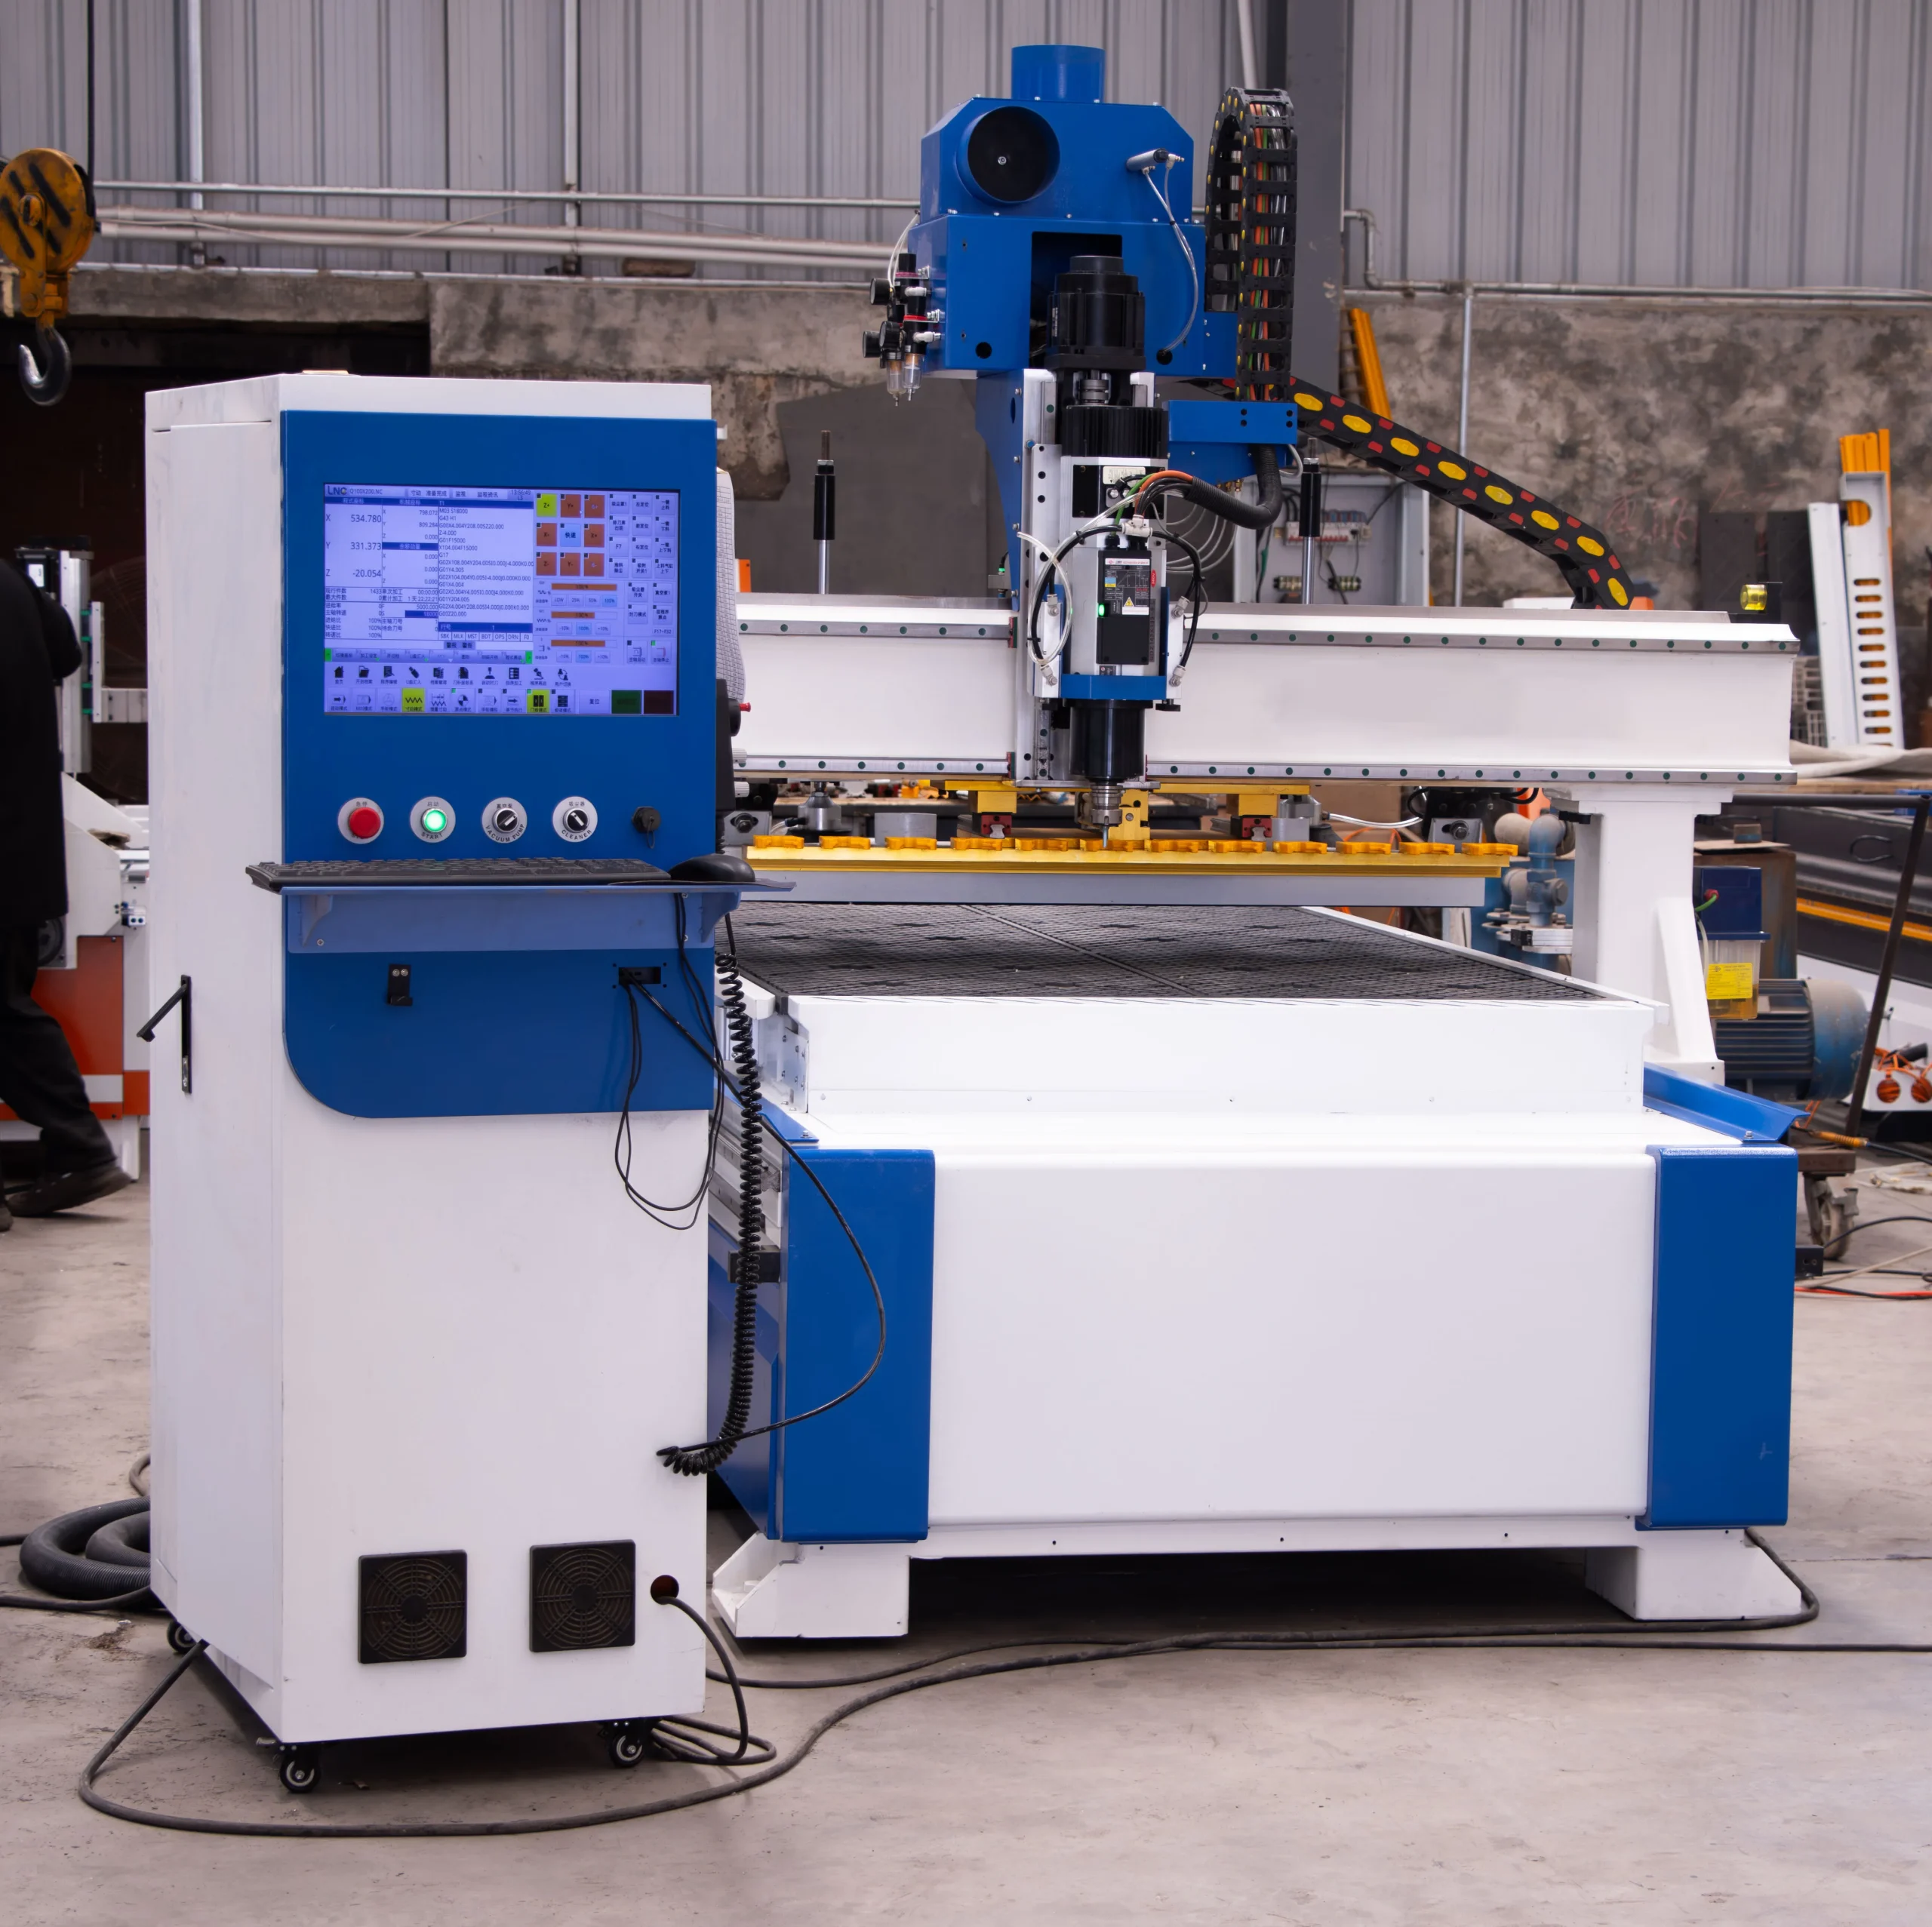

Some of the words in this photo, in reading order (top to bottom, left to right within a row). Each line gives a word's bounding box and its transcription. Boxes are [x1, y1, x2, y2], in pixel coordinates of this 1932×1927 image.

[328, 486, 347, 496] LNC
[350, 542, 381, 550] 331.373
[421, 831, 443, 840] START
[485, 825, 511, 842] VACUUM
[513, 823, 525, 840] PUMP
[561, 829, 592, 840] CLEANER
